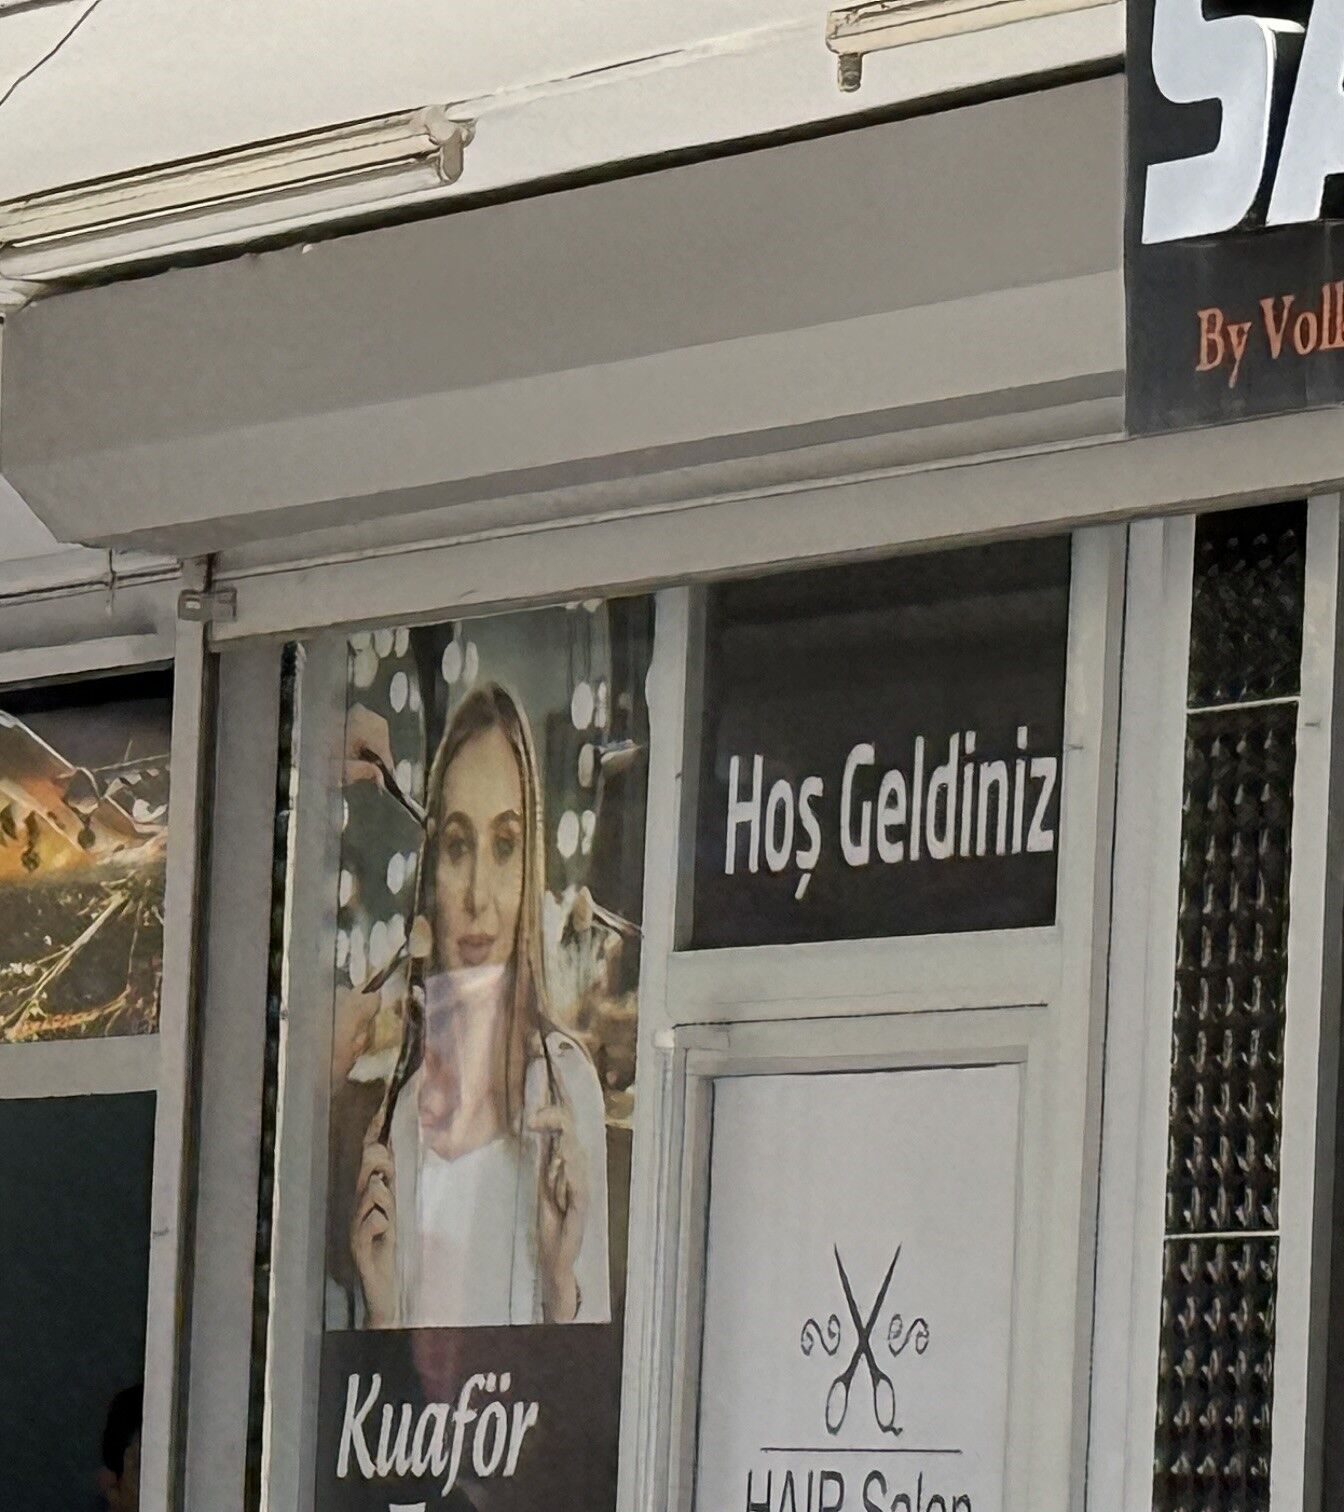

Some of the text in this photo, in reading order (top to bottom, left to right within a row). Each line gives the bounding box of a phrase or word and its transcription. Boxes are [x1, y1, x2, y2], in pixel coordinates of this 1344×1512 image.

[1195, 307, 1252, 389] By
[724, 725, 1058, 900] Hoş Geldiniz
[336, 1372, 540, 1498] Kuaför
